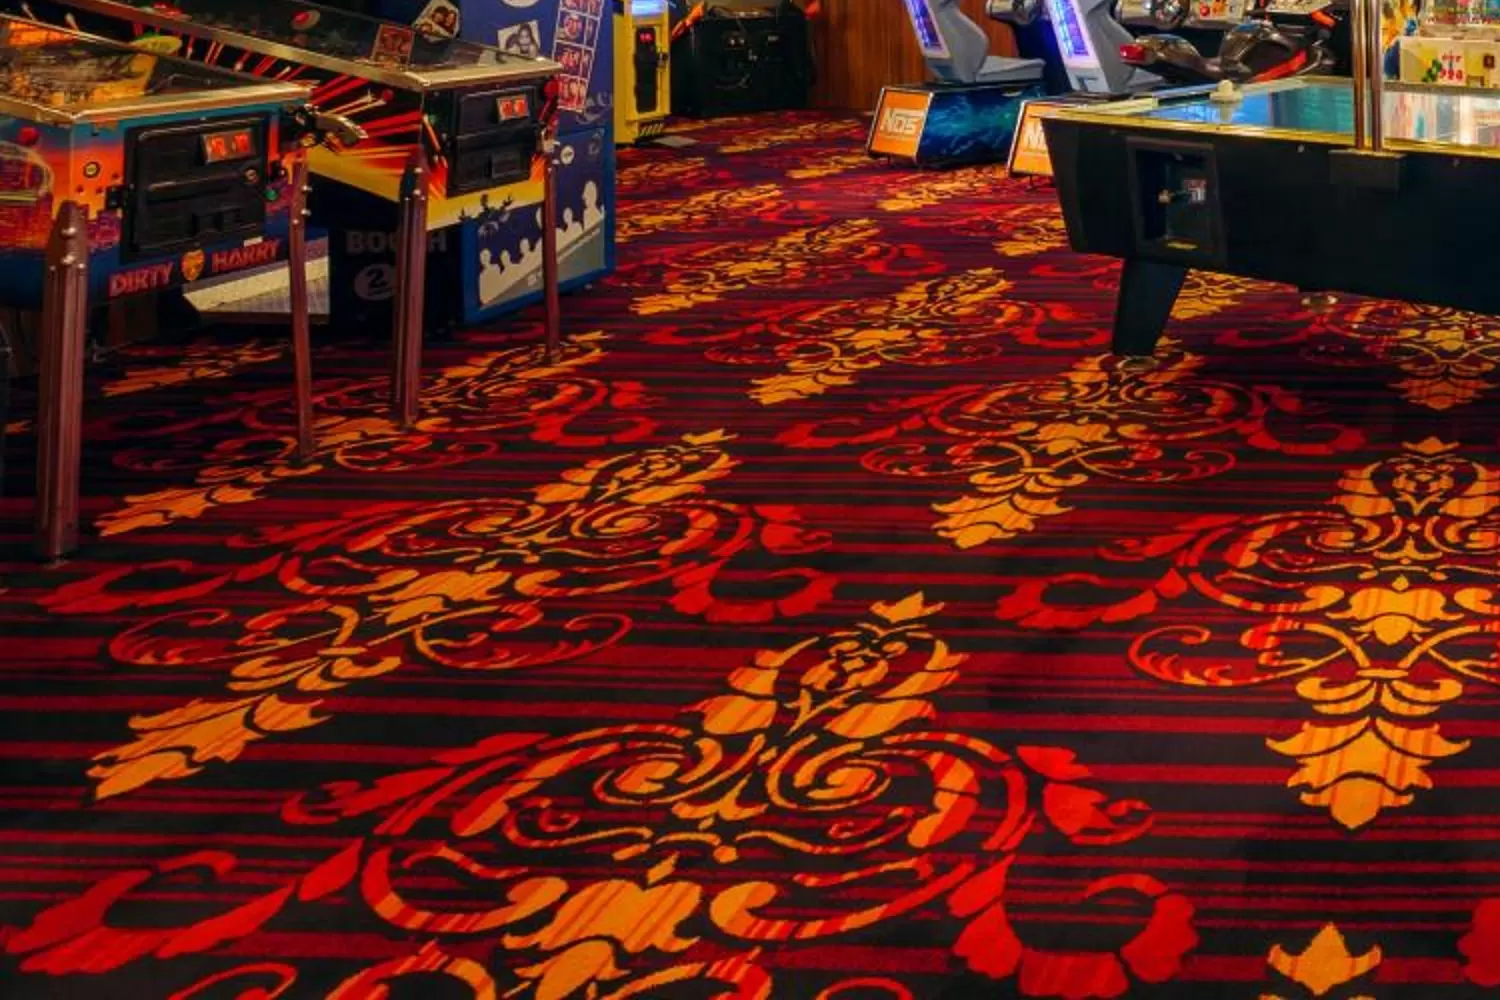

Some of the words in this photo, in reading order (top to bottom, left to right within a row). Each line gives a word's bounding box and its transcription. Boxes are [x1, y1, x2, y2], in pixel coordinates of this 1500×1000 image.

[879, 109, 923, 134] NOS
[212, 239, 280, 272] HARRY
[346, 231, 447, 253] BOH
[109, 261, 174, 297] DIRTY
